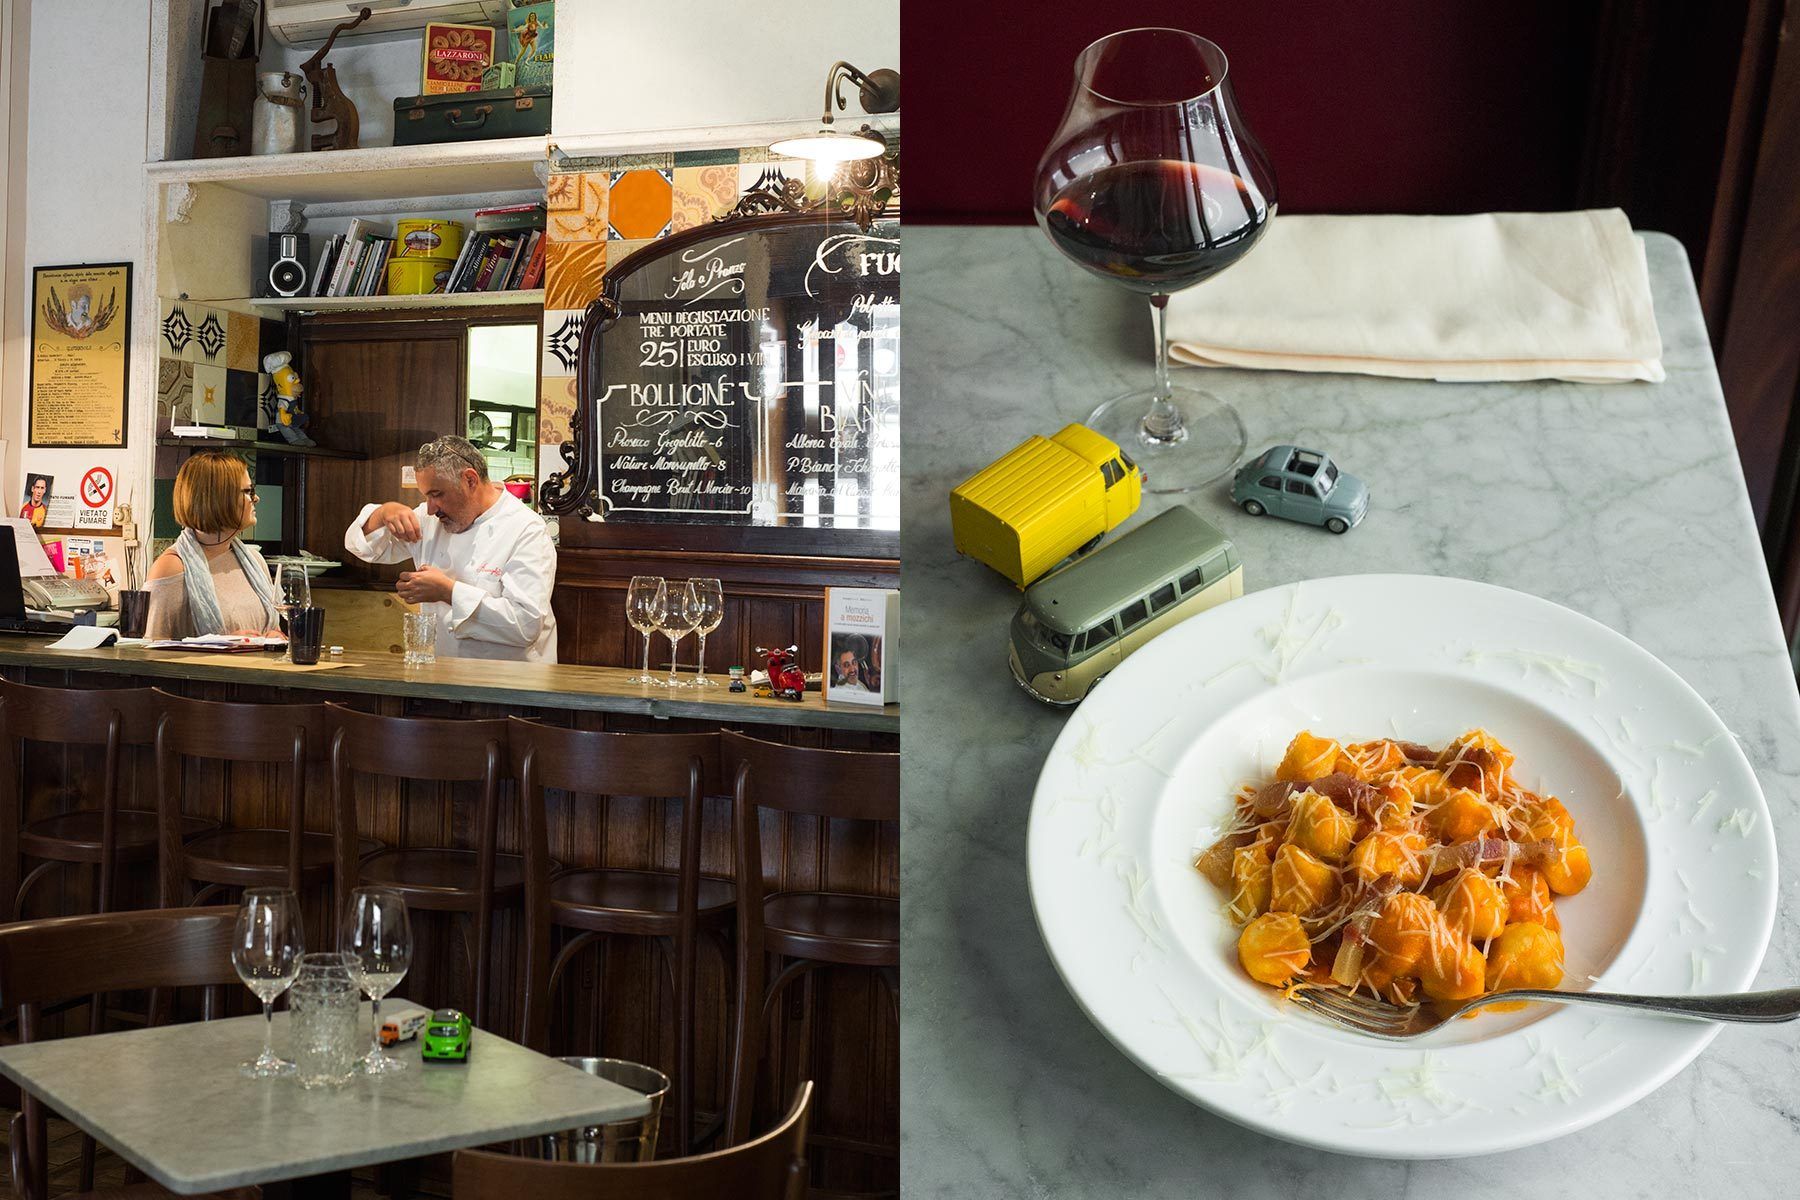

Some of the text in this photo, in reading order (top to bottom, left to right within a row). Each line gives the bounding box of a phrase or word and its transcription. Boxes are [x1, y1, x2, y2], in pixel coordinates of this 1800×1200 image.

[437, 50, 483, 60] LAZZARONI
[664, 257, 747, 299] Solo a Pranzo
[640, 308, 770, 324] MENU DEGUSTAZIONE
[640, 324, 727, 338] TRE PORTATE
[687, 339, 720, 352] EURO
[640, 341, 678, 367] 25
[687, 353, 737, 366] ESCLUSO
[630, 376, 735, 406] BOLLICINE
[607, 427, 650, 448] Prosecco
[611, 479, 661, 503] Champagne
[666, 478, 694, 495] Brut
[80, 510, 107, 518] VIETATO
[845, 606, 869, 614] Memoria
